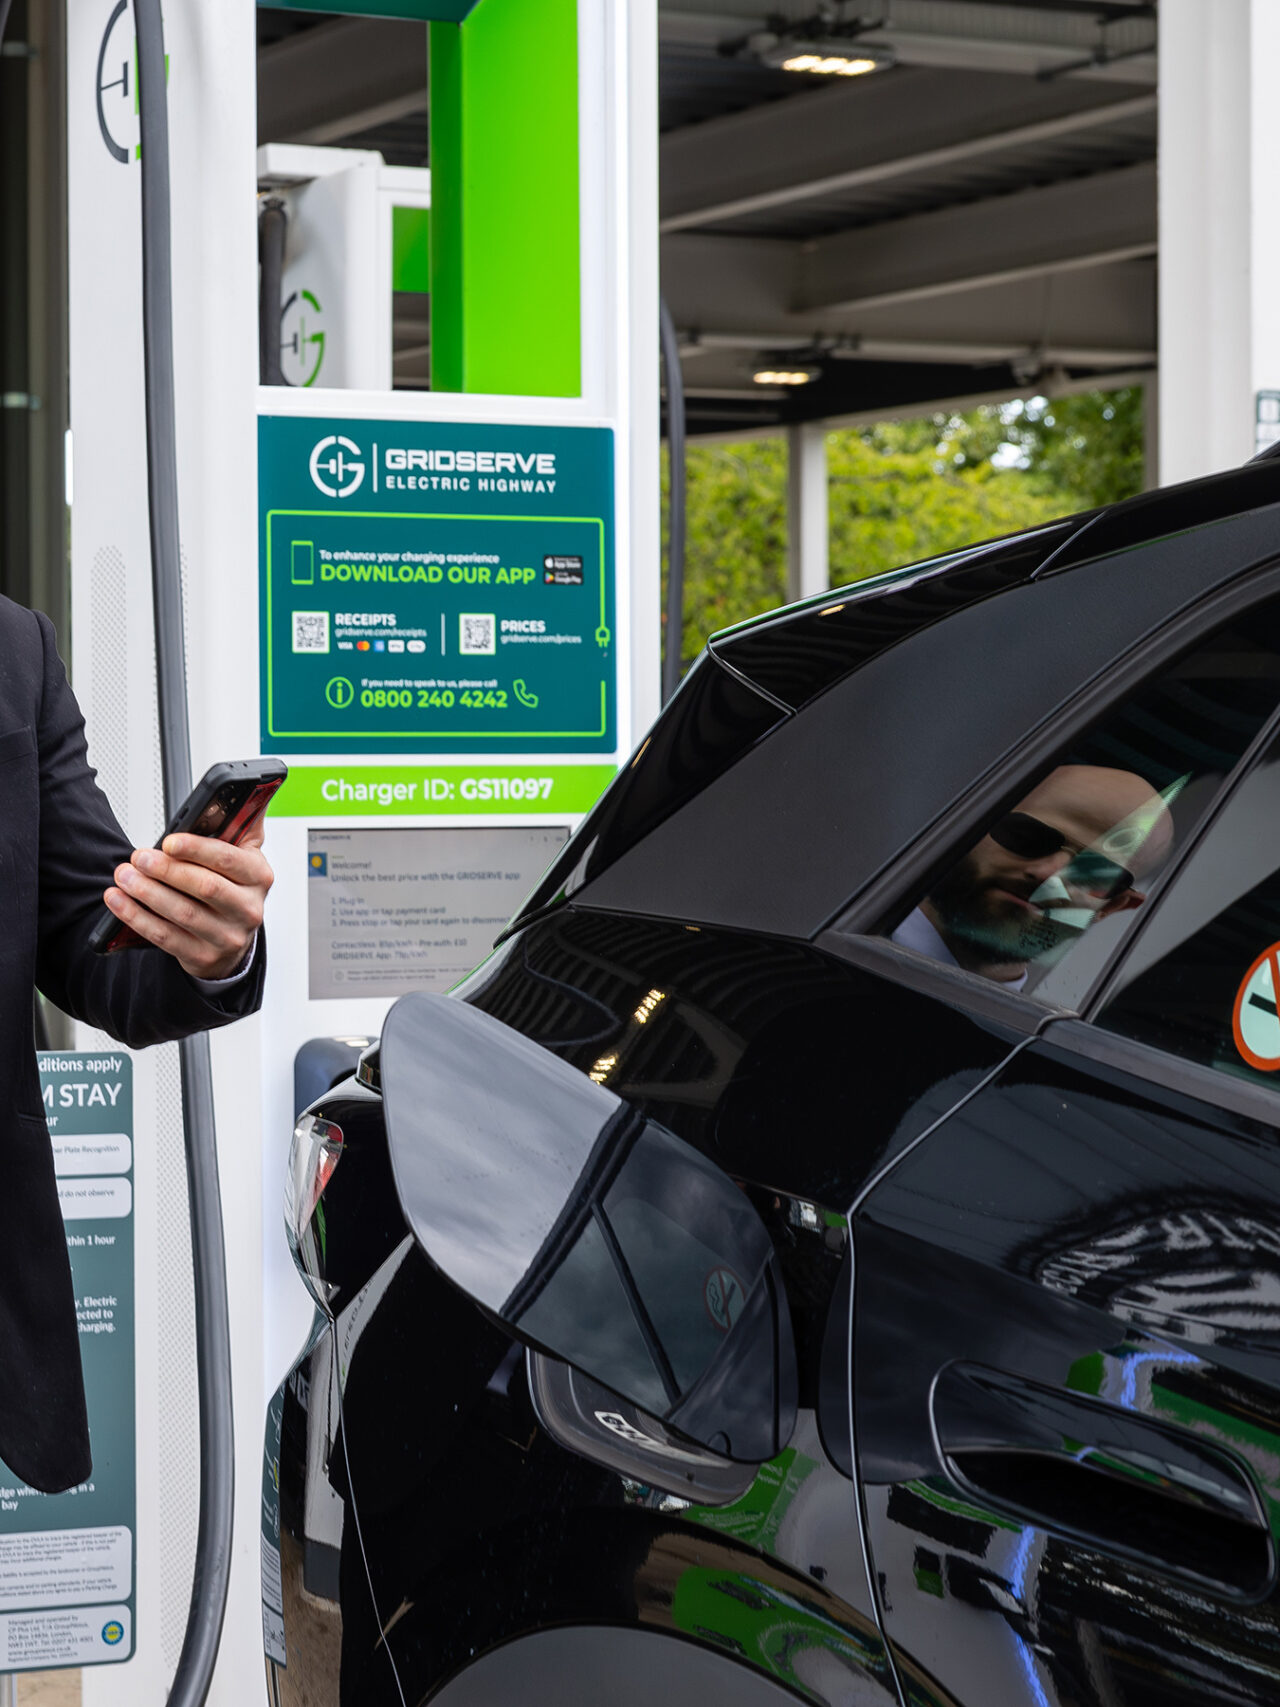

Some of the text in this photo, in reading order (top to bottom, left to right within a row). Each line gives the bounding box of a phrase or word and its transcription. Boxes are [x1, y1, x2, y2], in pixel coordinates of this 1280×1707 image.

[385, 448, 556, 475] GRIDSERVE
[386, 475, 556, 493] ELECTRIC HIGHWAY
[320, 550, 500, 564] To enhance your charging experience
[320, 564, 536, 585] DOWNLOAD OUR APP
[335, 613, 397, 626] RECEIPTS
[335, 628, 427, 638] gridserve.com/receipts
[501, 620, 546, 633] PRICES
[368, 679, 383, 689] you
[383, 678, 404, 687] need
[404, 678, 413, 687] to
[414, 678, 436, 688] speak
[437, 679, 446, 687] to
[459, 679, 483, 689] please
[484, 679, 498, 688] call
[360, 689, 508, 708] 0800 240 4242
[321, 778, 554, 805] Charger ID: GS11097
[377, 873, 396, 881] best
[398, 873, 419, 883] price
[440, 872, 455, 880] the
[456, 871, 503, 881] GRIDSERVE
[39, 1056, 123, 1074] ditions apply
[59, 1083, 123, 1108] STAY
[46, 1116, 58, 1127] ur
[87, 1234, 93, 1246] 1
[94, 1234, 116, 1246] hour
[83, 1295, 118, 1308] Electric
[76, 1308, 114, 1320] ected to
[79, 1321, 116, 1334] harging.
[88, 1483, 95, 1492] a
[1, 1500, 19, 1511] bay
